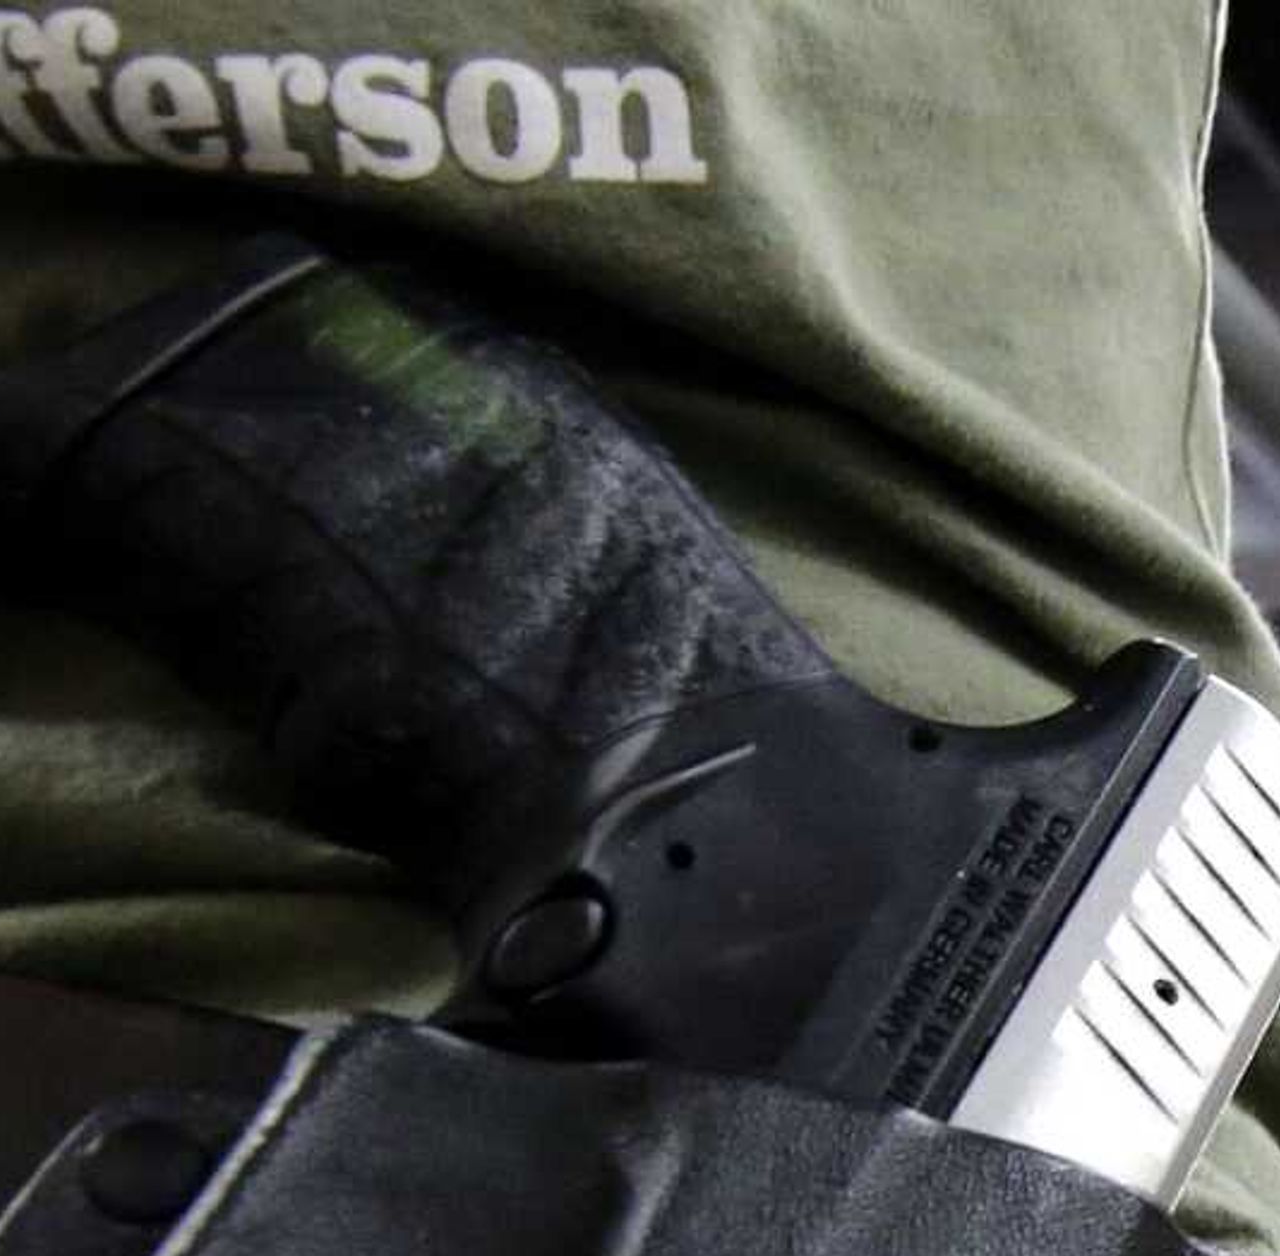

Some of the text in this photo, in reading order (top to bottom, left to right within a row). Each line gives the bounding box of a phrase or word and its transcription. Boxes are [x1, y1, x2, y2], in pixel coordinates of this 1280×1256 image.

[978, 792, 1044, 879] MADE
[1016, 811, 1077, 889] CARL
[873, 902, 974, 1046] GERMANY
[936, 884, 1034, 1026] WALTHER
